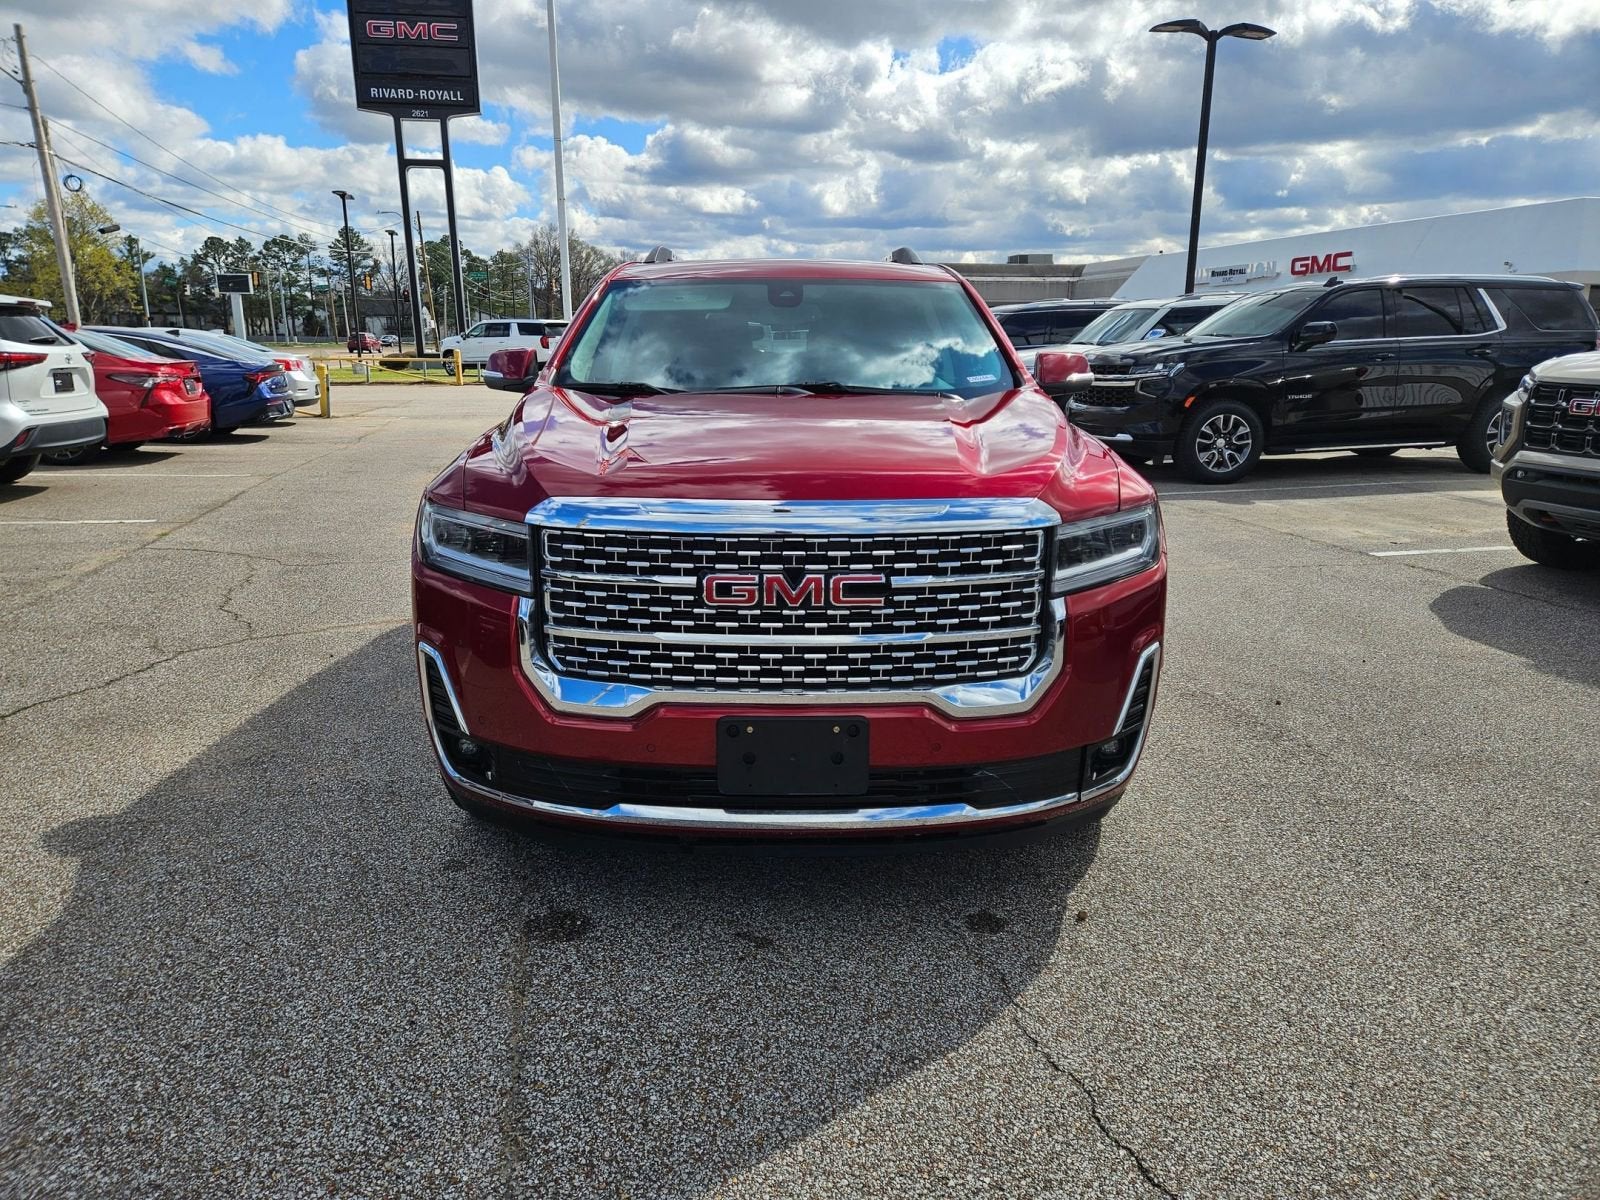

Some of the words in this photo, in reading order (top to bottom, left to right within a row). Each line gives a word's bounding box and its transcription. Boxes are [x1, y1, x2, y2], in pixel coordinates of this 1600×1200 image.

[366, 20, 459, 41] GMC
[370, 87, 464, 101] RIVARD-ROYALL
[411, 109, 429, 118] 2621
[1291, 251, 1353, 276] GMC
[702, 573, 886, 607] GMC
